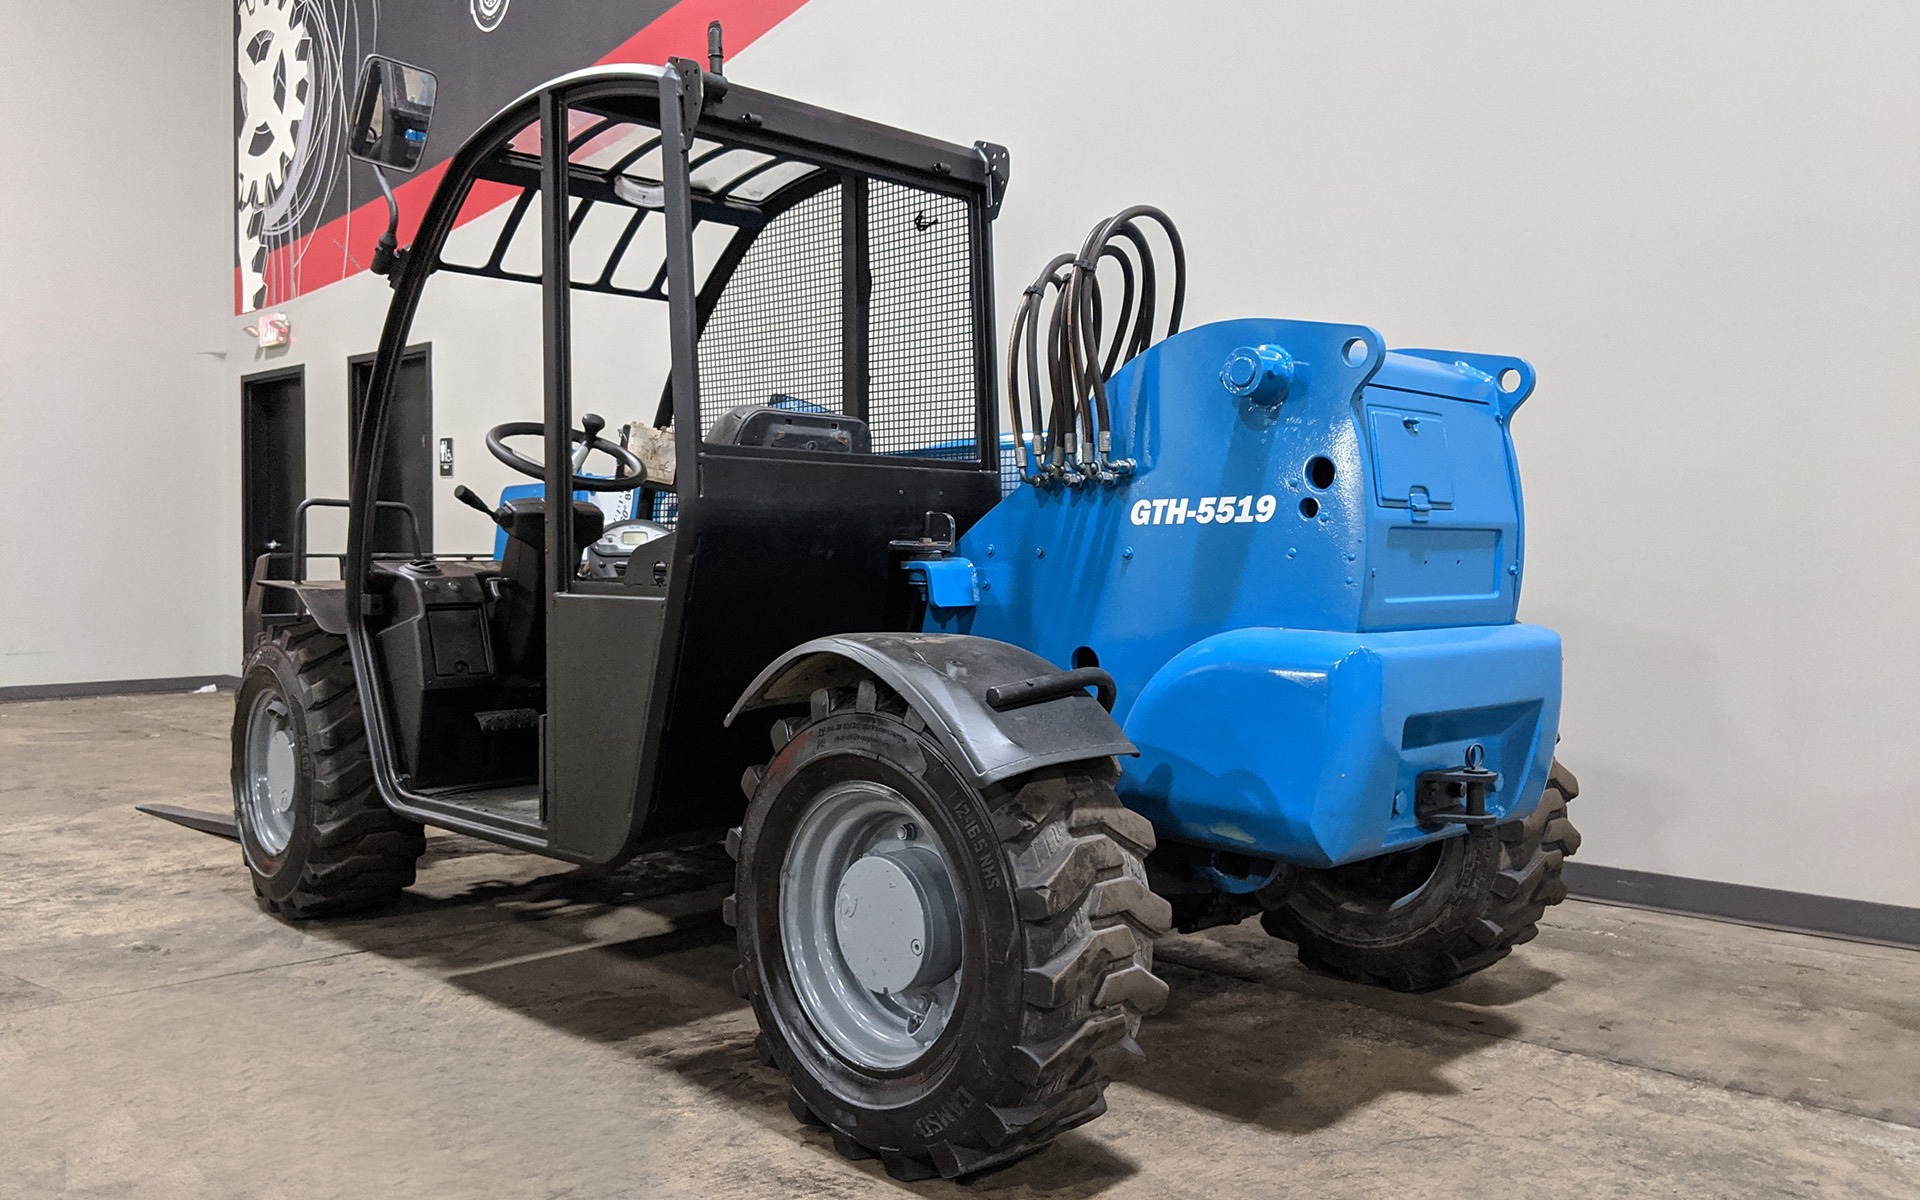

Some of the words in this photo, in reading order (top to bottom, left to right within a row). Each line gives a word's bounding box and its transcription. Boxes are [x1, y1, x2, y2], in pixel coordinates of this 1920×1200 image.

[1130, 494, 1276, 525] GTH-5519
[953, 801, 989, 853] 12-16.5
[979, 853, 1001, 889] NHS
